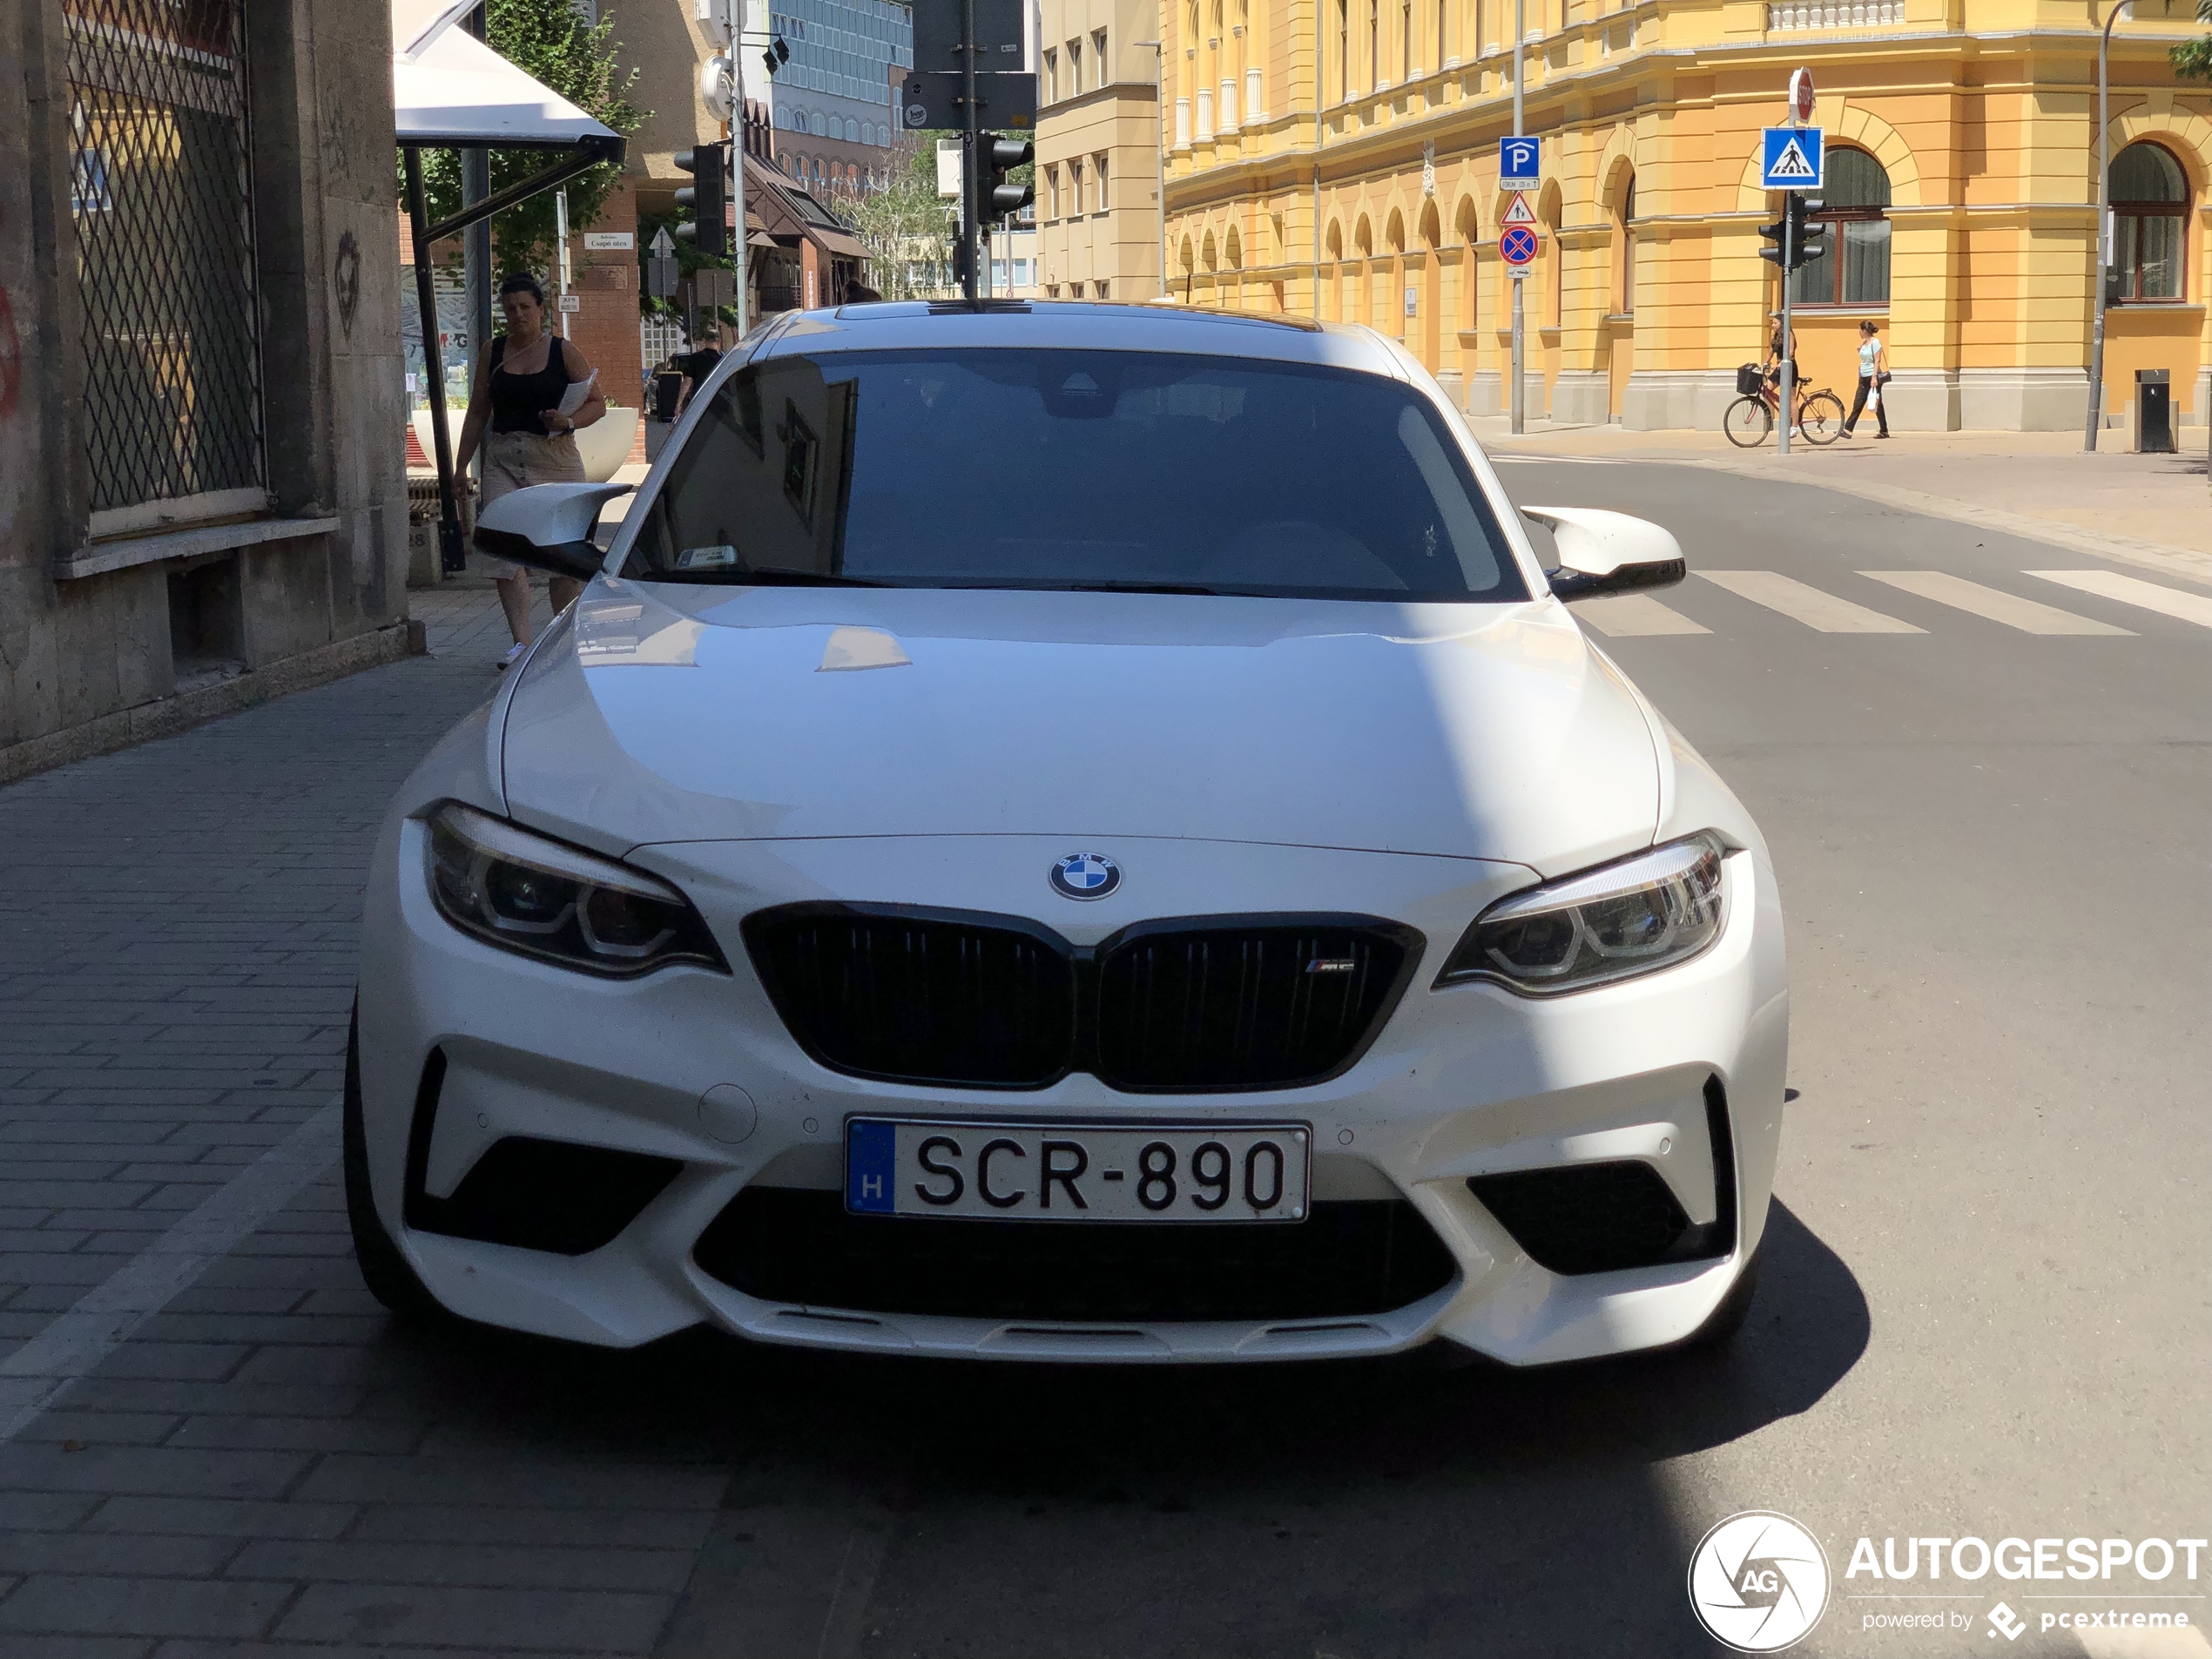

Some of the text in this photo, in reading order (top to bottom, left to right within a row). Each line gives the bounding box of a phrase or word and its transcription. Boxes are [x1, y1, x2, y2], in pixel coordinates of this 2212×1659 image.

[1798, 84, 1811, 105] STOP
[1513, 149, 1530, 172] P
[1058, 853, 1115, 868] BMW
[862, 1136, 1284, 1211] H SCR-890
